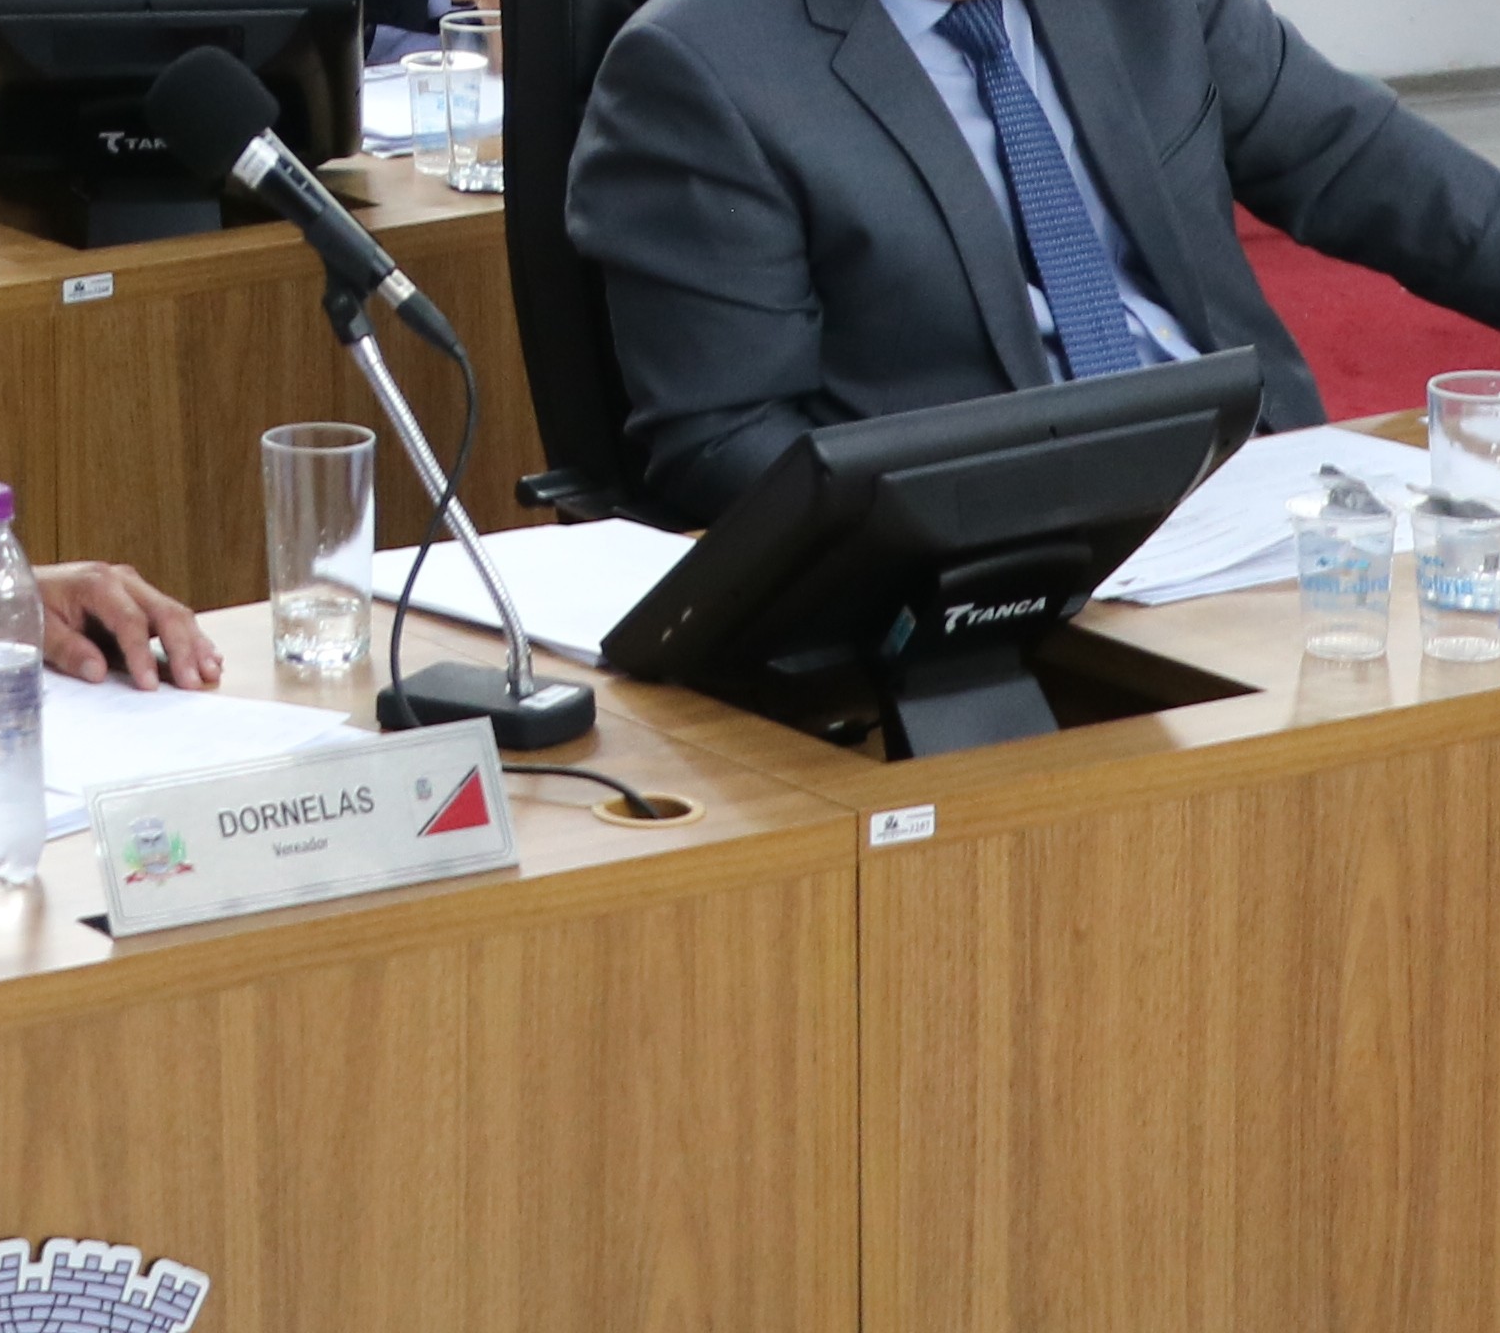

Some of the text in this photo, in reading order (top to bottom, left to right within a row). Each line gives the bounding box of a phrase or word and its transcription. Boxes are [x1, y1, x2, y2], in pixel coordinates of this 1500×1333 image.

[966, 596, 1047, 625] TANCA
[218, 786, 375, 838] DORNELAS
[272, 835, 329, 860] Vereador
